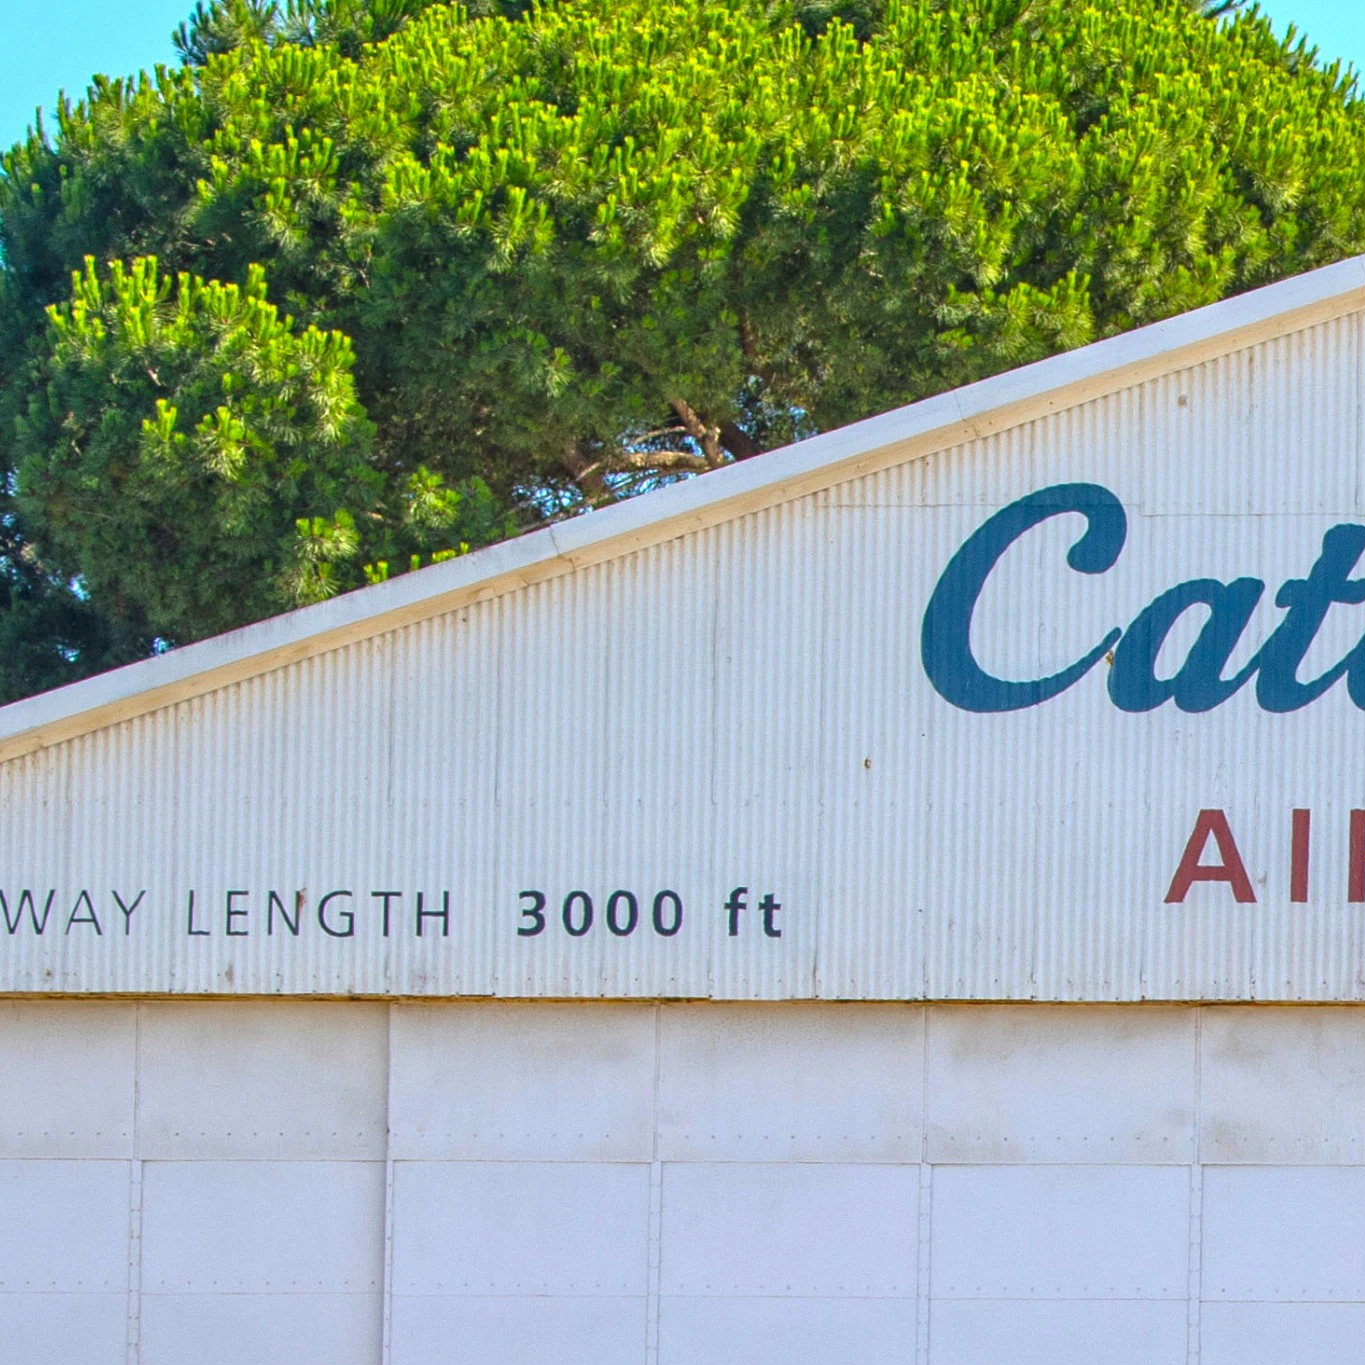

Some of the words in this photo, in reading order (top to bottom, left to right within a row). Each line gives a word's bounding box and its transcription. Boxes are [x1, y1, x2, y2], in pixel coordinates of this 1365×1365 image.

[0, 888, 147, 936] WAY
[187, 889, 451, 938] LENGTH
[516, 889, 684, 938] 3000
[723, 886, 783, 938] ft
